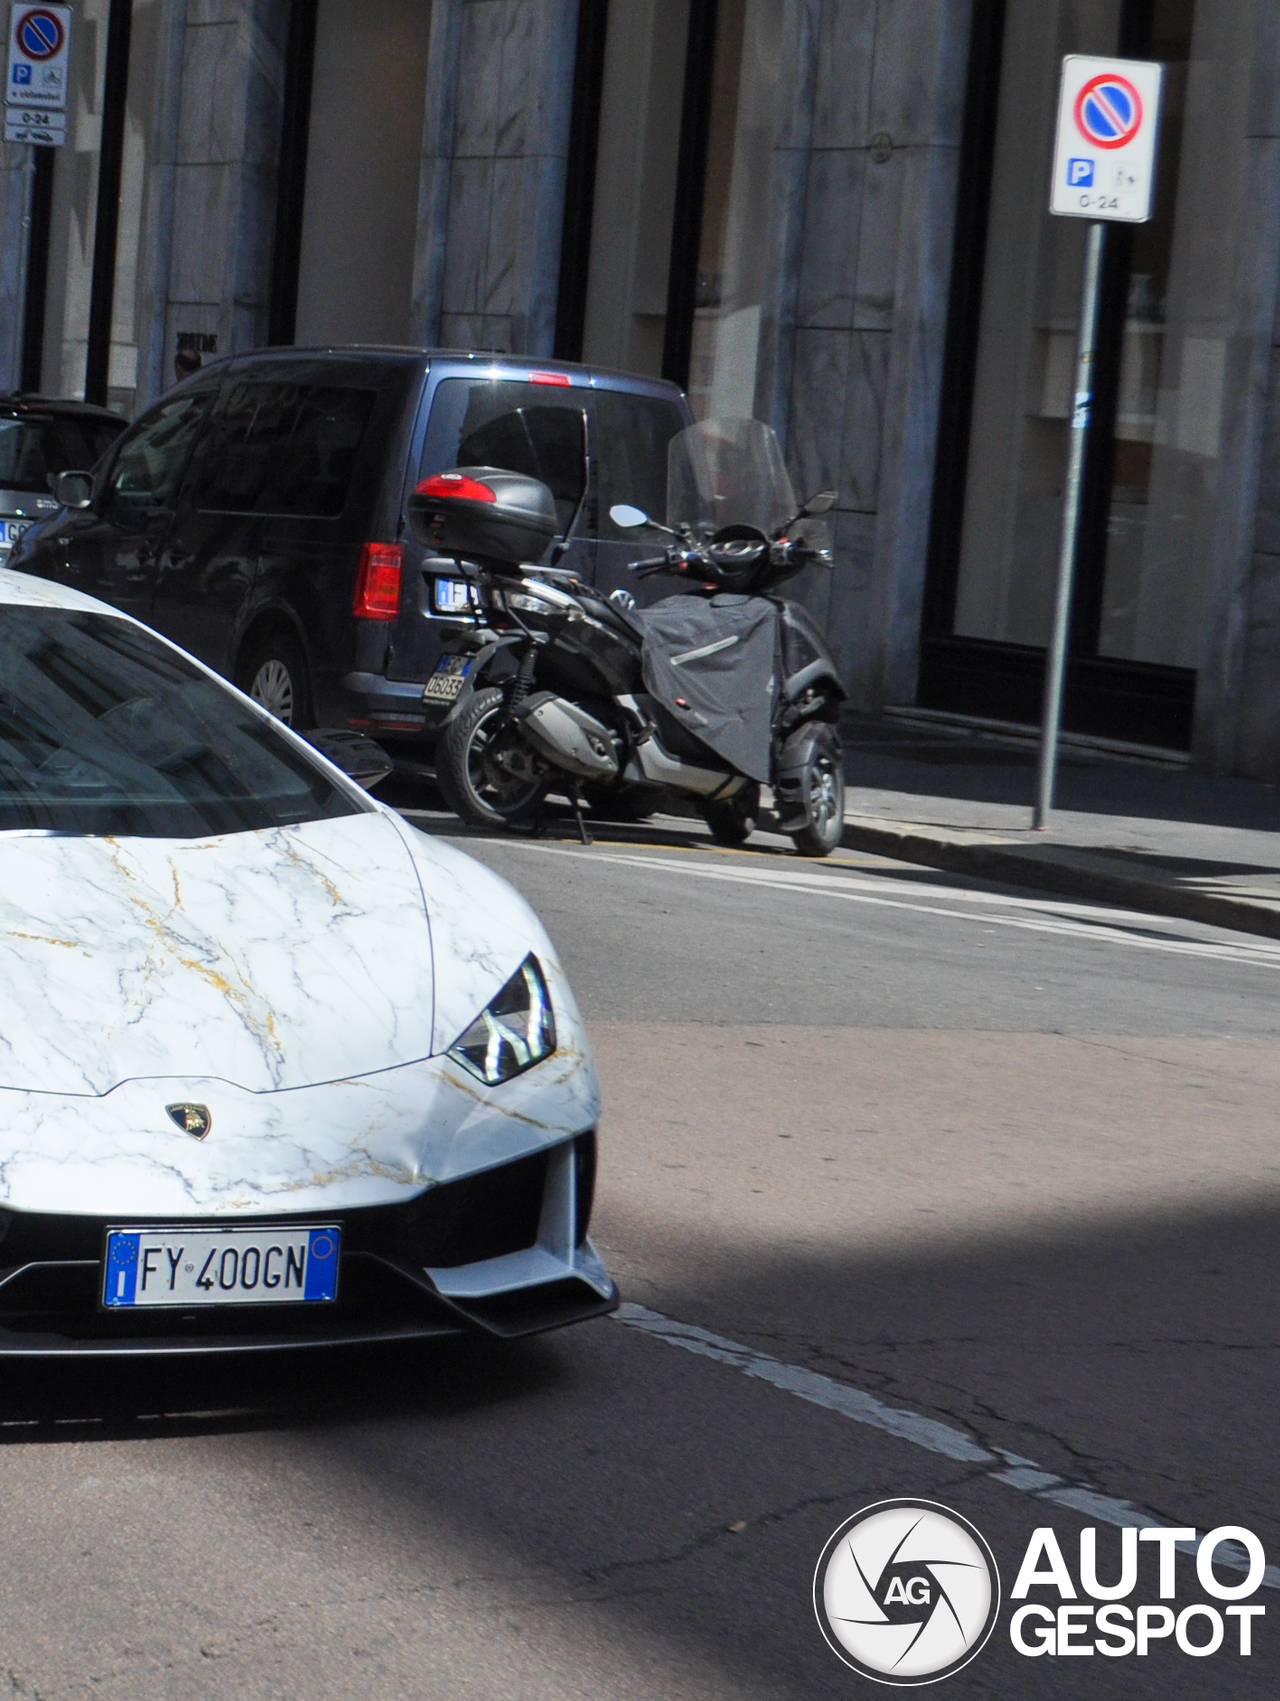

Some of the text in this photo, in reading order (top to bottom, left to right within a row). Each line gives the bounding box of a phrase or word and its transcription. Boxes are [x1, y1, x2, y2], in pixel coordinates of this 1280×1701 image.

[16, 66, 29, 83] P
[22, 112, 49, 124] 0-24
[1072, 161, 1091, 184] P
[1079, 194, 1119, 210] 0-24
[141, 1246, 185, 1291] FY
[196, 1244, 306, 1291] 400GN
